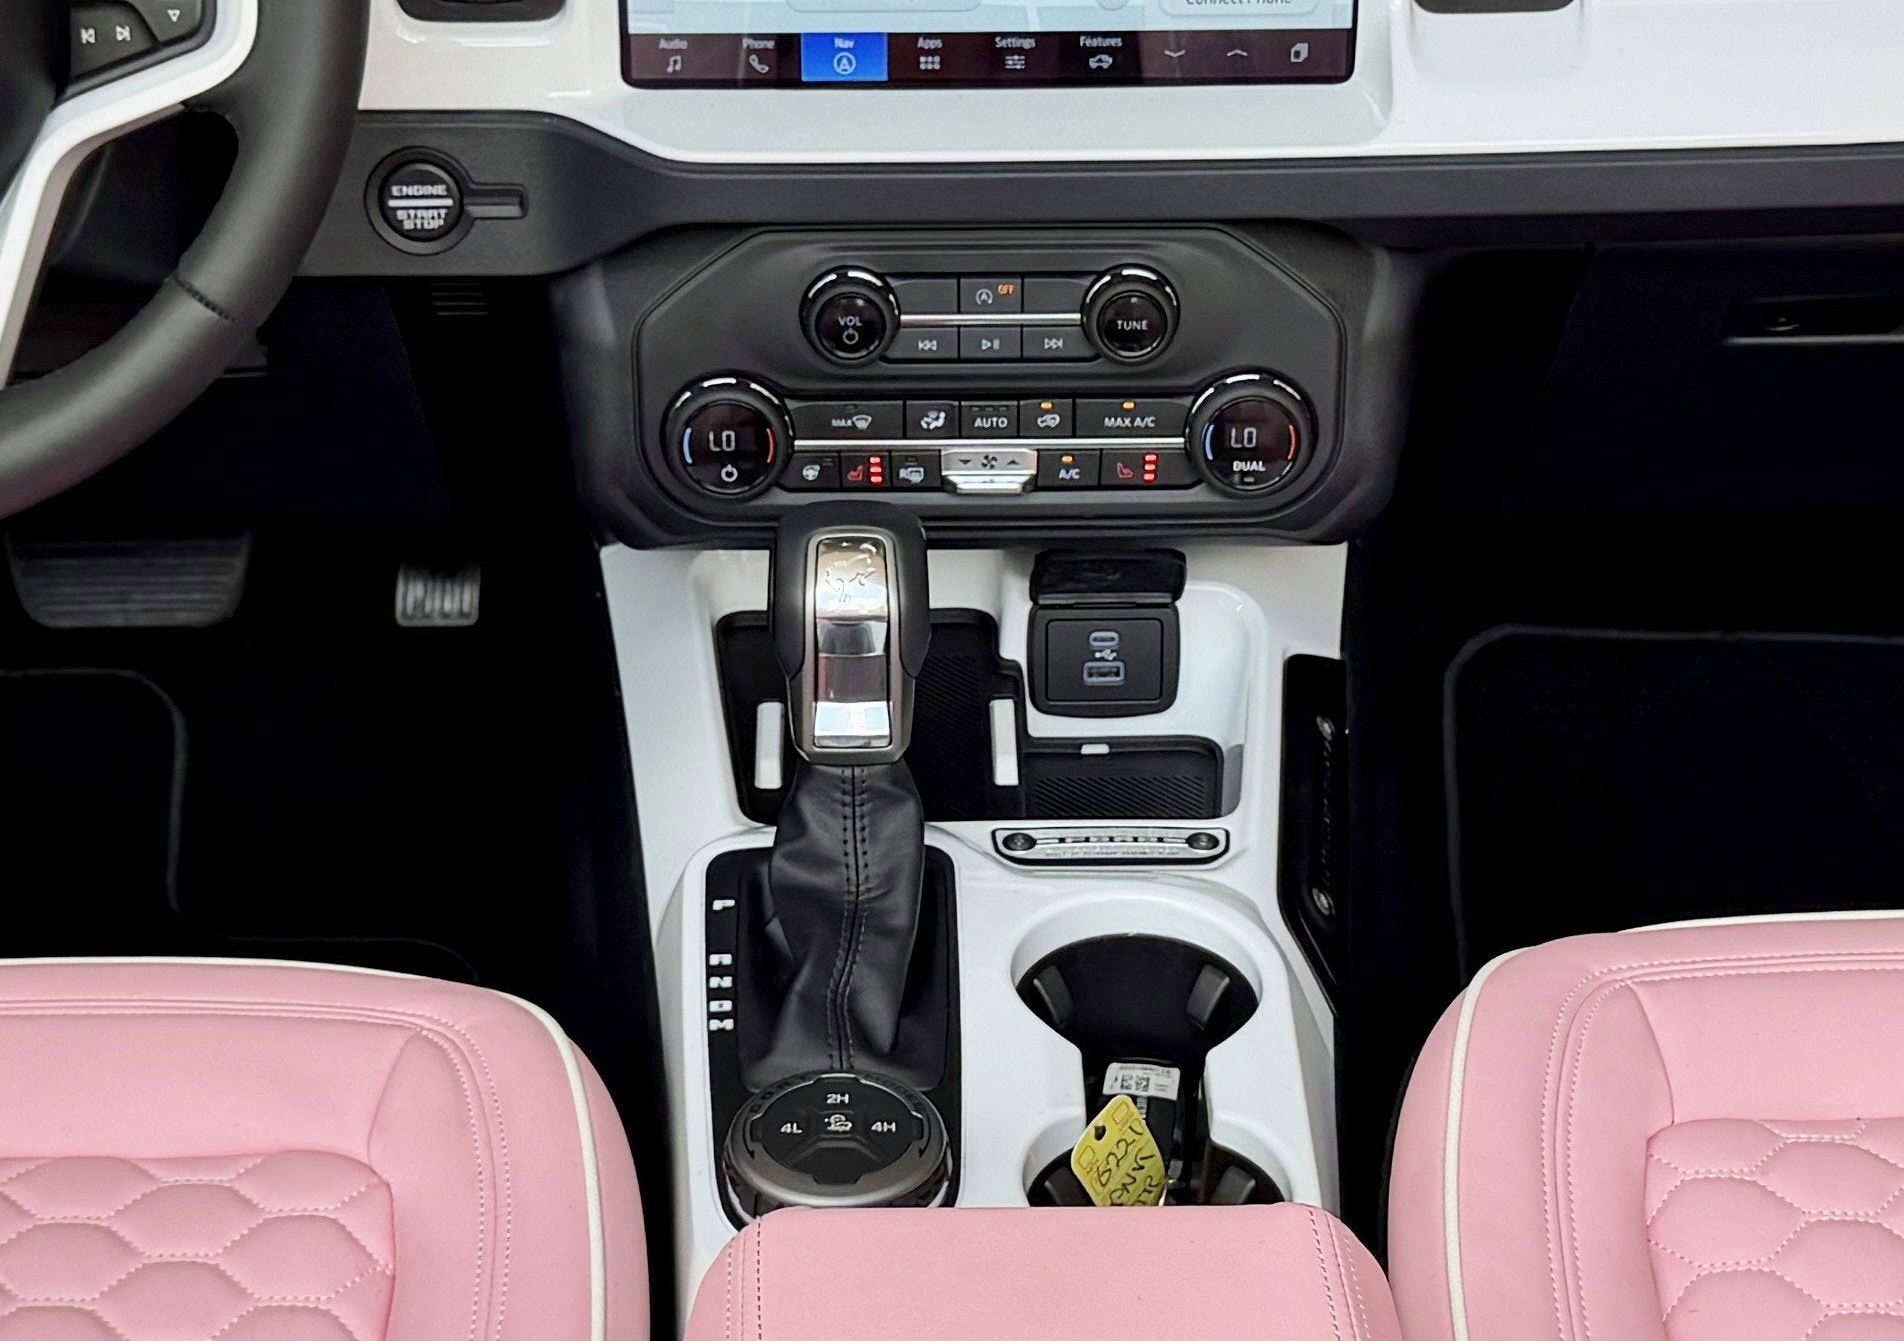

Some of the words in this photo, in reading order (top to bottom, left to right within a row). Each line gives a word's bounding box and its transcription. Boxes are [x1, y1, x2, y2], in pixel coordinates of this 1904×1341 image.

[658, 38, 689, 51] Audio
[742, 37, 776, 50] Phone
[834, 37, 856, 49] Nav
[917, 36, 944, 51] Apps
[995, 36, 1036, 50] Settings
[1079, 35, 1123, 48] Features
[390, 184, 449, 197] ENGINE
[396, 208, 448, 221] START
[403, 218, 445, 230] STOP
[838, 315, 863, 327] VOL
[1116, 319, 1149, 331] TUNE
[973, 416, 1008, 429] AUTO
[1103, 416, 1132, 428] MAX
[1134, 415, 1157, 429] A/C
[1232, 460, 1267, 472] DUAL
[1057, 466, 1081, 481] A/C
[712, 899, 736, 911] P
[708, 976, 733, 988] N
[826, 1093, 850, 1104] 2H
[780, 1121, 803, 1134] 4L
[870, 1121, 897, 1133] 4H
